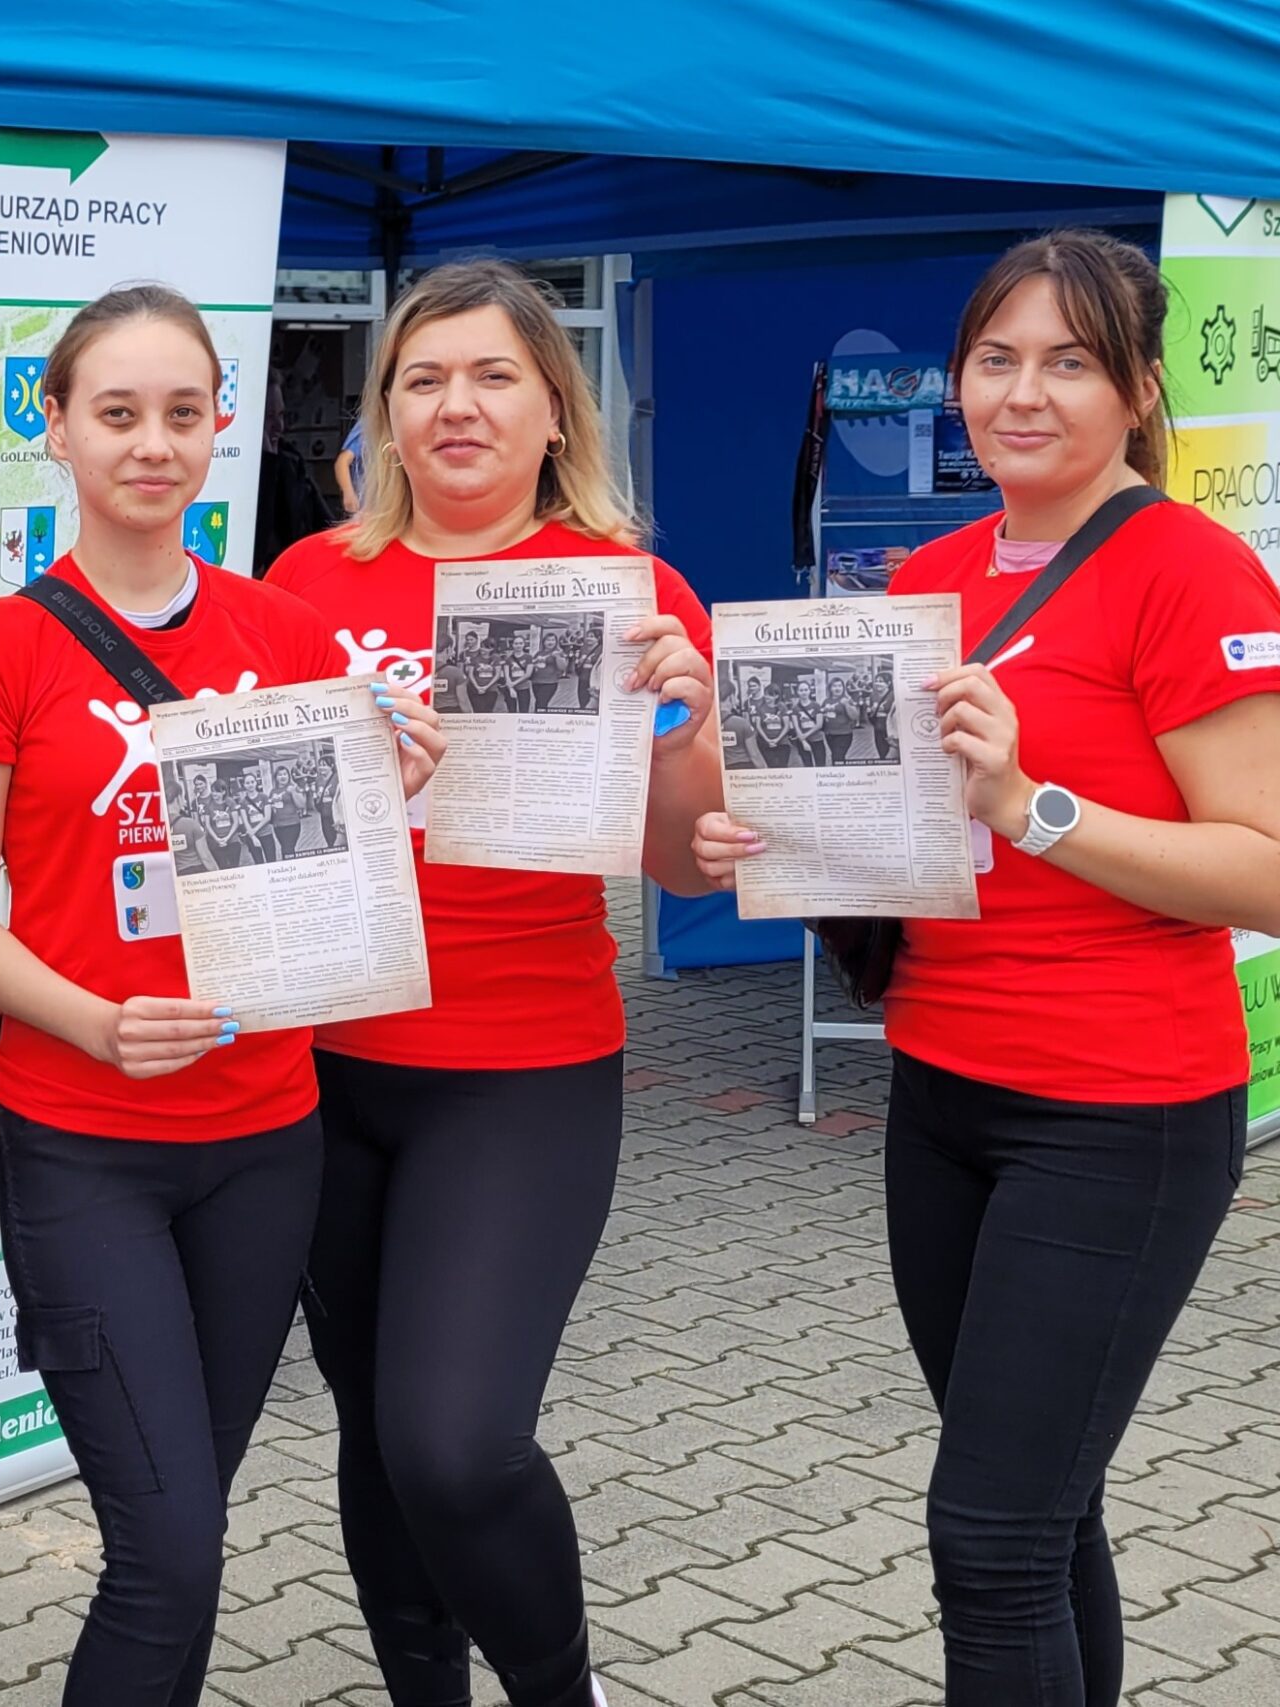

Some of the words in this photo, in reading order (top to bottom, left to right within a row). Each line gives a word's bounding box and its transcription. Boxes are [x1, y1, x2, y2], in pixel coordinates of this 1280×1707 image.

[0, 195, 80, 227] URZĄD
[87, 200, 167, 226] PRACY
[0, 450, 55, 463] GOLENIO
[210, 446, 241, 459] GARD
[475, 580, 566, 601] Goleniów
[571, 577, 621, 598] News
[50, 590, 118, 653] BILLABONG
[755, 621, 851, 643] Goleniów
[857, 618, 915, 639] News
[131, 667, 170, 704] BILLA
[194, 713, 290, 740] Goleniów
[295, 703, 350, 726] News
